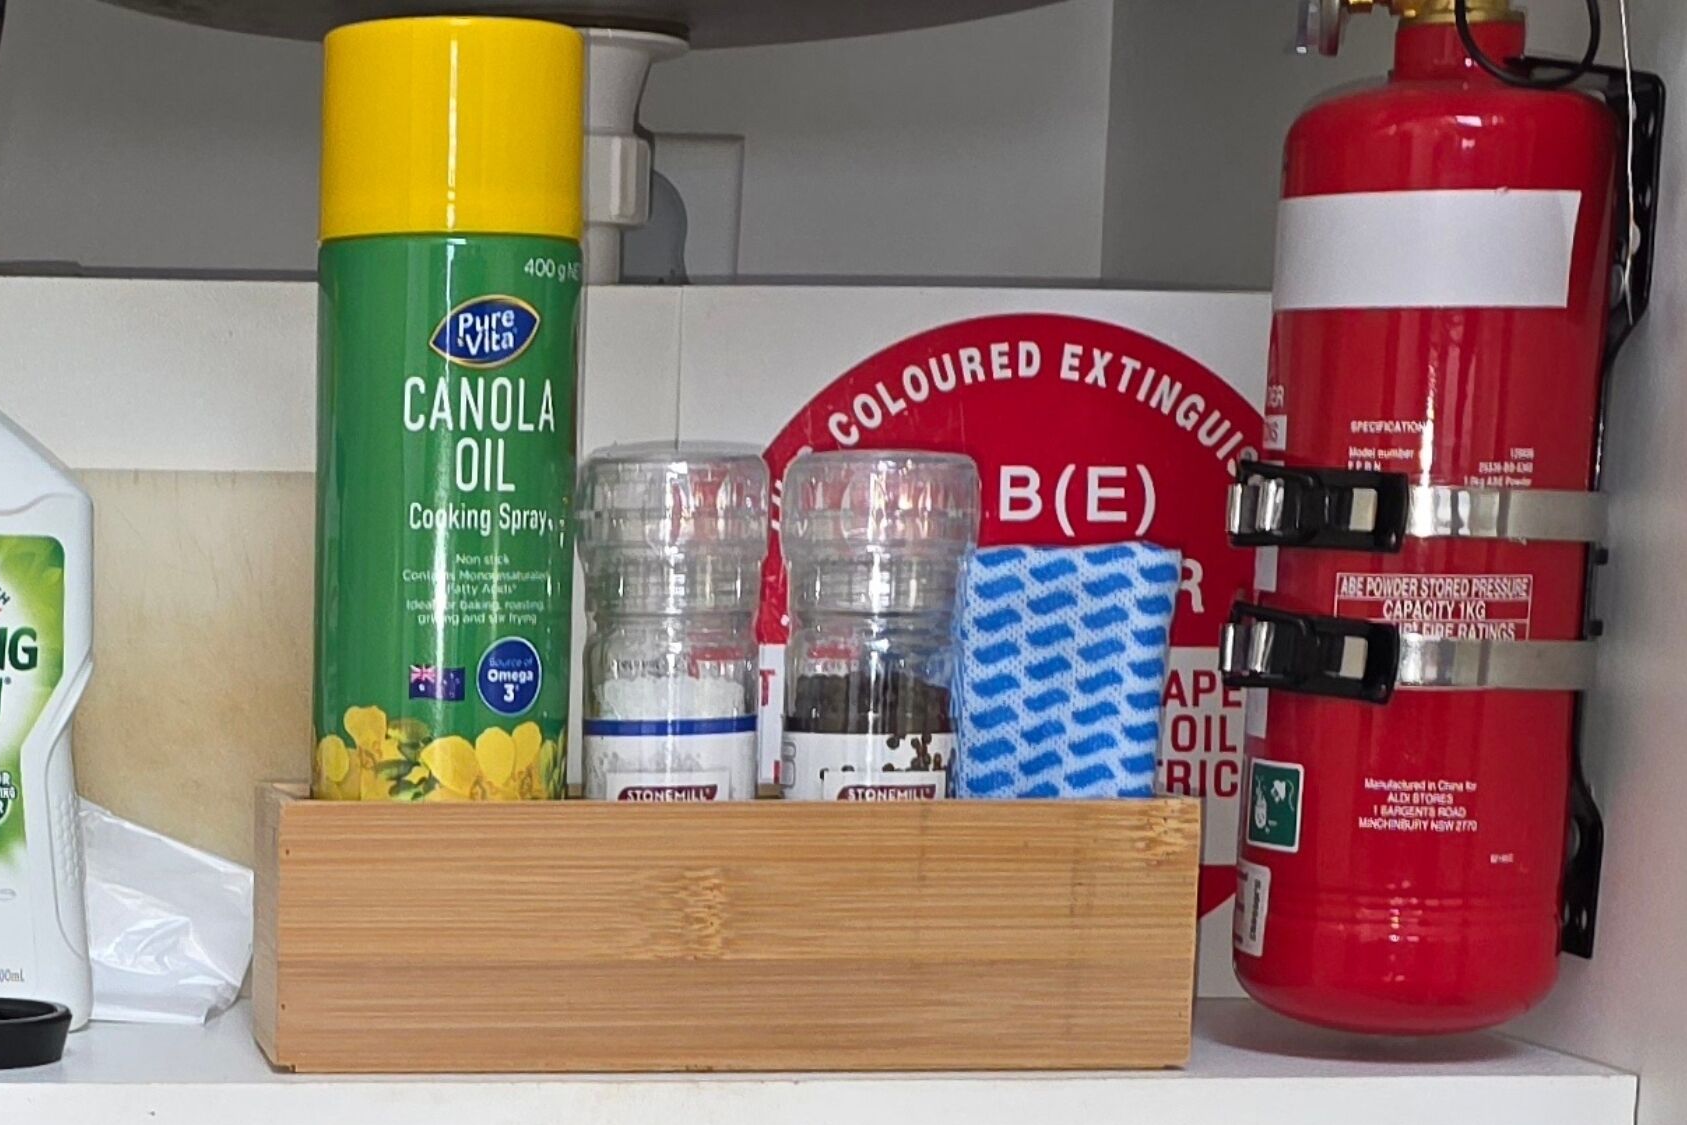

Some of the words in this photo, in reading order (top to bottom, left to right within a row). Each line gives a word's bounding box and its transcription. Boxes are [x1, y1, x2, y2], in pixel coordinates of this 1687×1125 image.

[458, 309, 515, 338] Pure
[465, 330, 515, 356] Vita
[403, 376, 555, 432] CANOLA
[828, 341, 1042, 447] COLOURED
[456, 437, 516, 492] OIL
[999, 464, 1157, 537] B(E)
[409, 502, 492, 537] Cooking
[498, 502, 547, 537] Spray
[1339, 576, 1365, 597] ABE
[1366, 576, 1418, 599] POWDER
[1419, 577, 1470, 600] STORED
[1471, 577, 1529, 600] PRESSURE
[1382, 598, 1456, 620] CAPACITY
[1459, 599, 1486, 620] 1KG
[1457, 622, 1516, 641] RATINGS
[487, 669, 534, 684] Omega
[503, 683, 515, 703] 3
[1171, 714, 1238, 753] OIL
[626, 787, 709, 801] STONEMILL
[847, 788, 930, 801] STONEMILL
